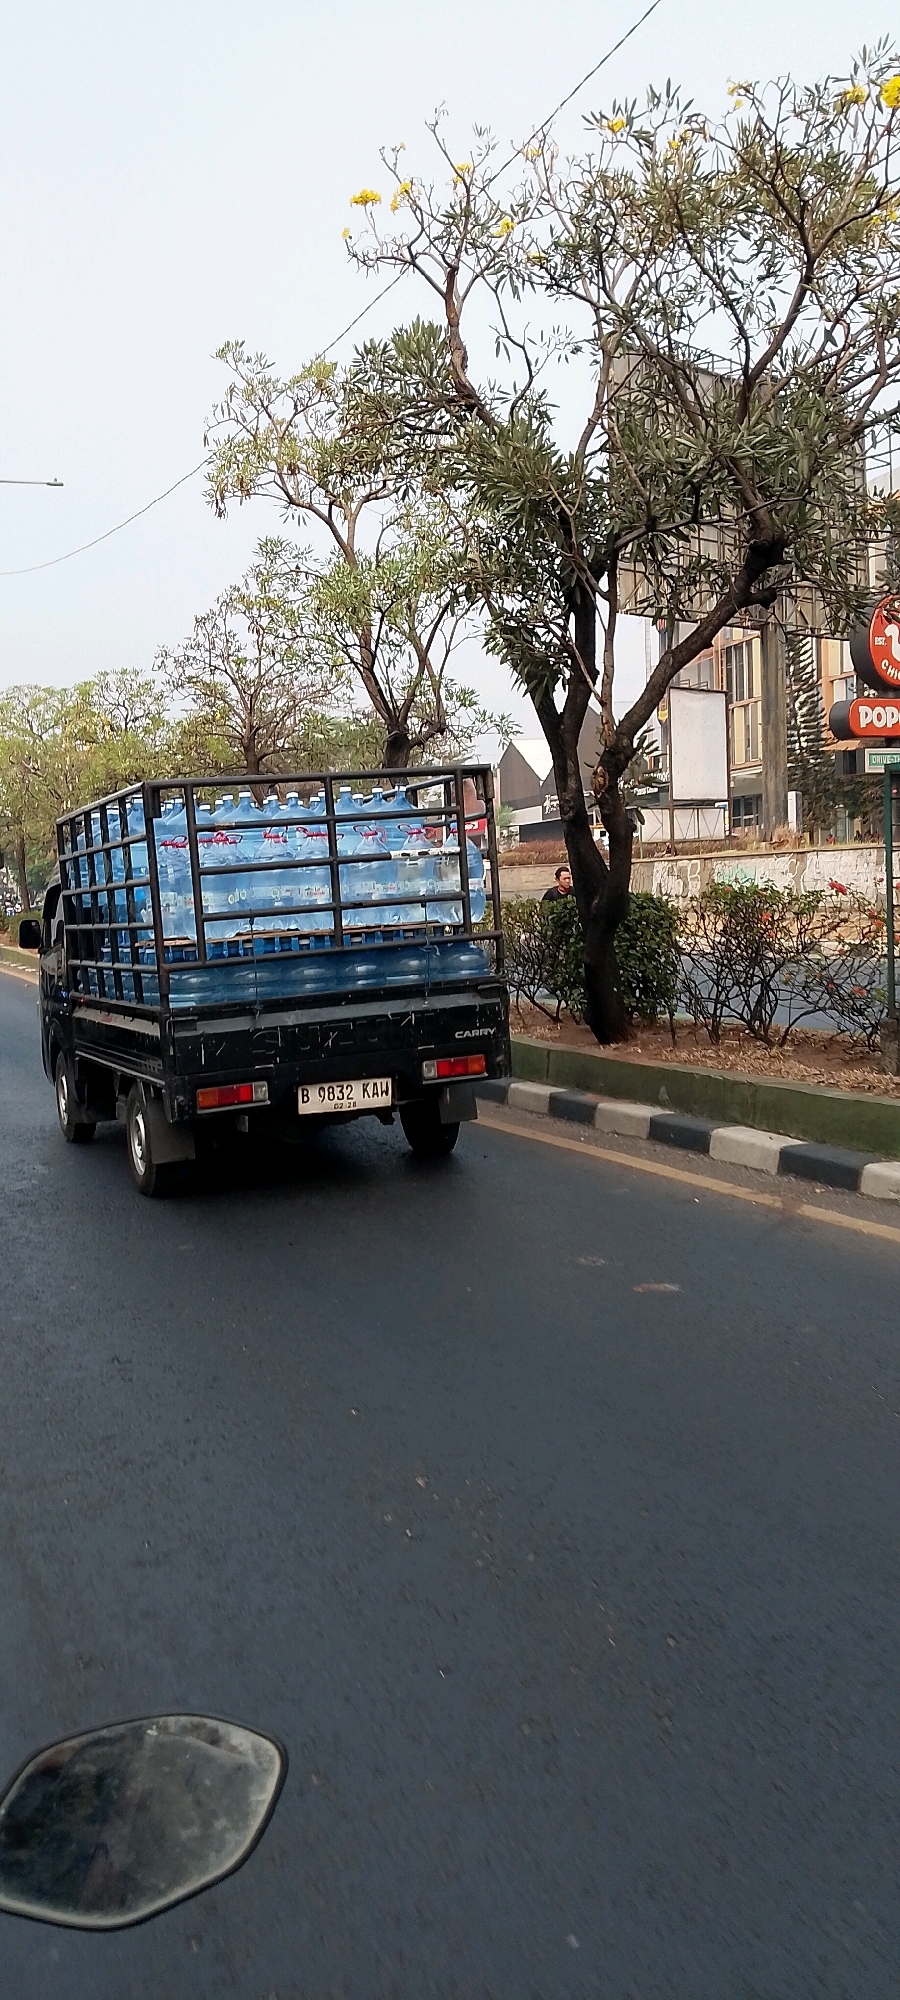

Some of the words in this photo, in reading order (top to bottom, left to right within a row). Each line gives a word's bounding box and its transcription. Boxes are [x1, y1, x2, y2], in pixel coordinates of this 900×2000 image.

[858, 705, 900, 728] POP
[455, 1027, 497, 1039] CARRY
[301, 1088, 310, 1104] B
[318, 1084, 354, 1103] 9832
[362, 1081, 389, 1099] KAW
